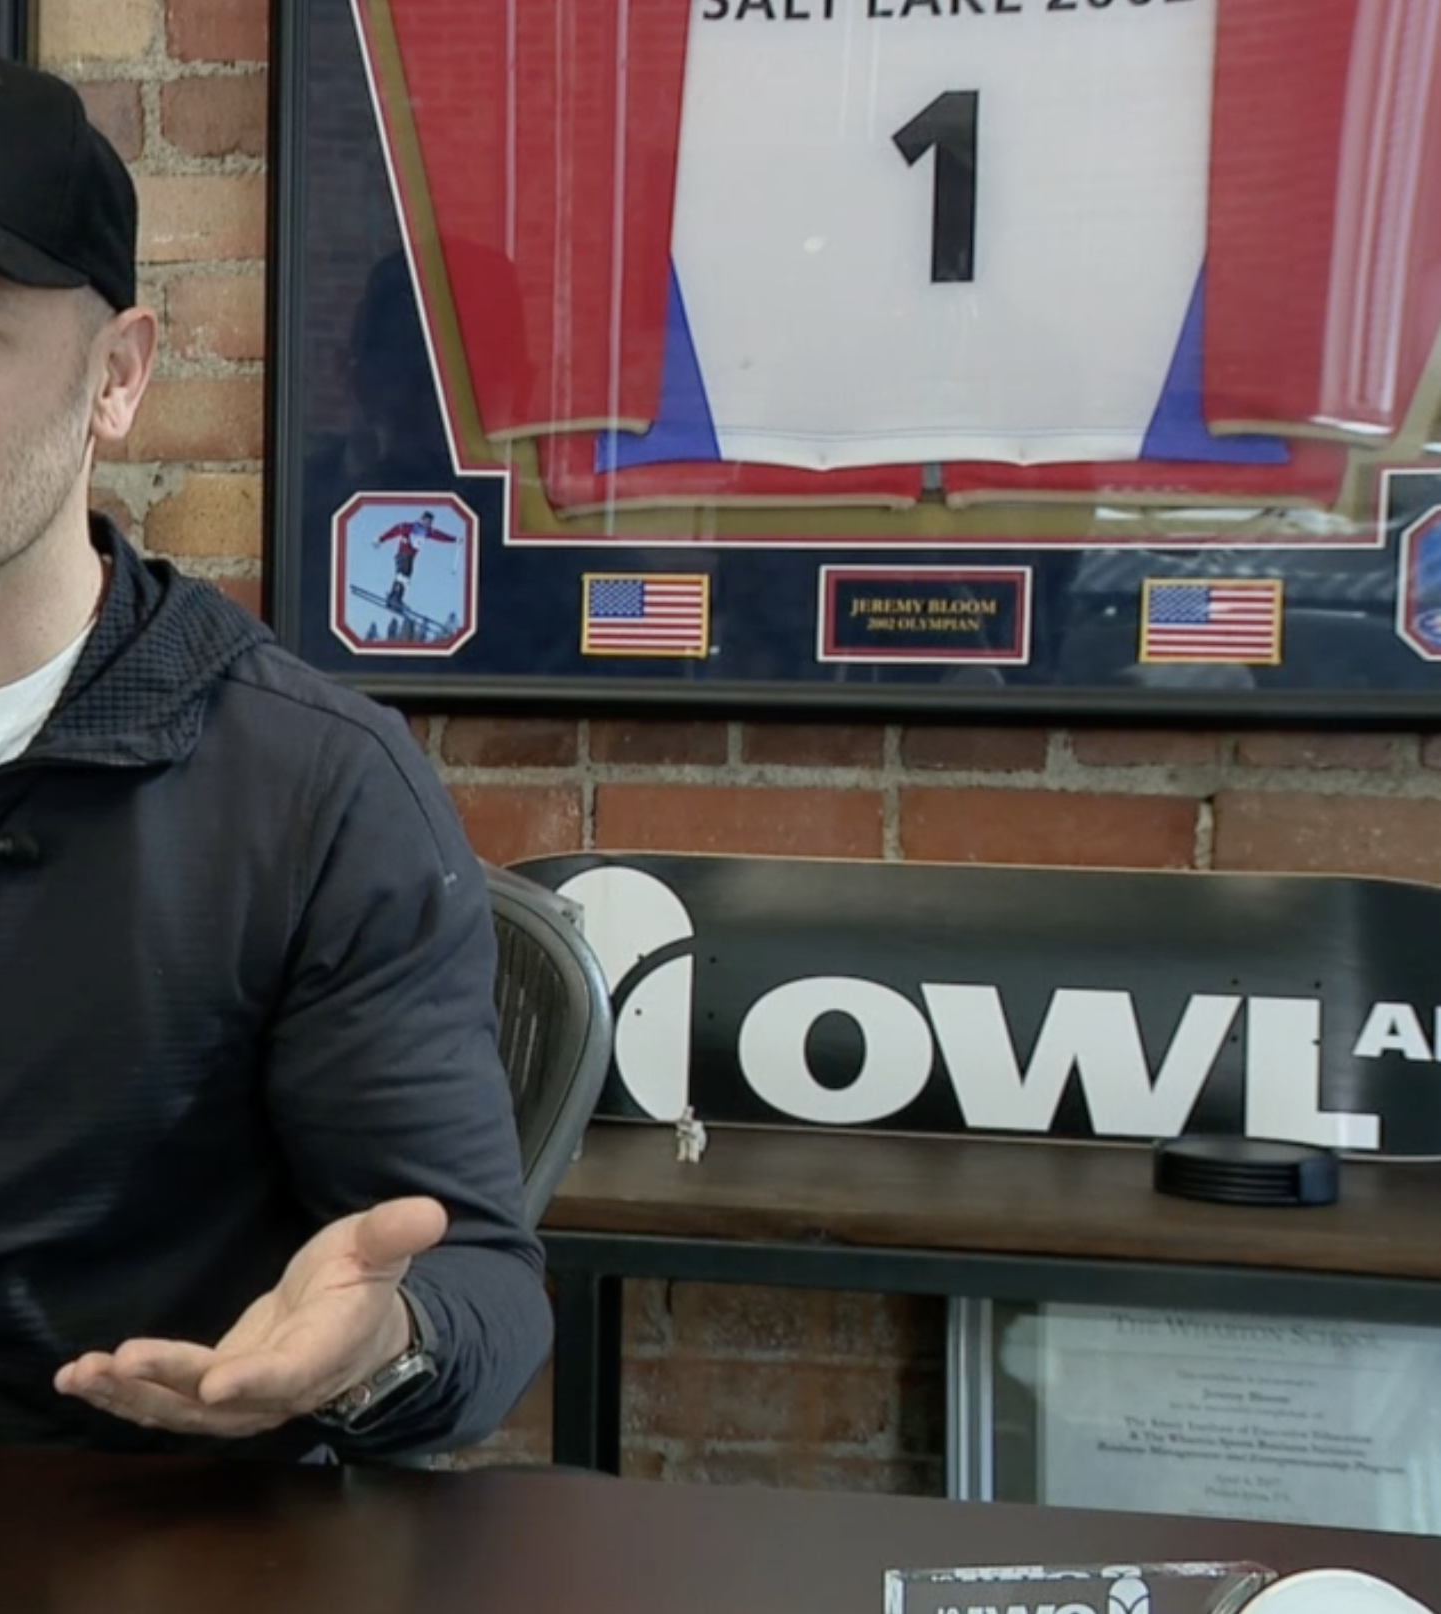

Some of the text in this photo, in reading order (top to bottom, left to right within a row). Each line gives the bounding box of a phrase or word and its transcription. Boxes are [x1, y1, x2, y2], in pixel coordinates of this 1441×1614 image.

[891, 89, 979, 284] 1
[850, 598, 997, 616] JEREMY BLOOM
[897, 617, 980, 631] OLYMPIAN
[738, 974, 1381, 1150] OWL
